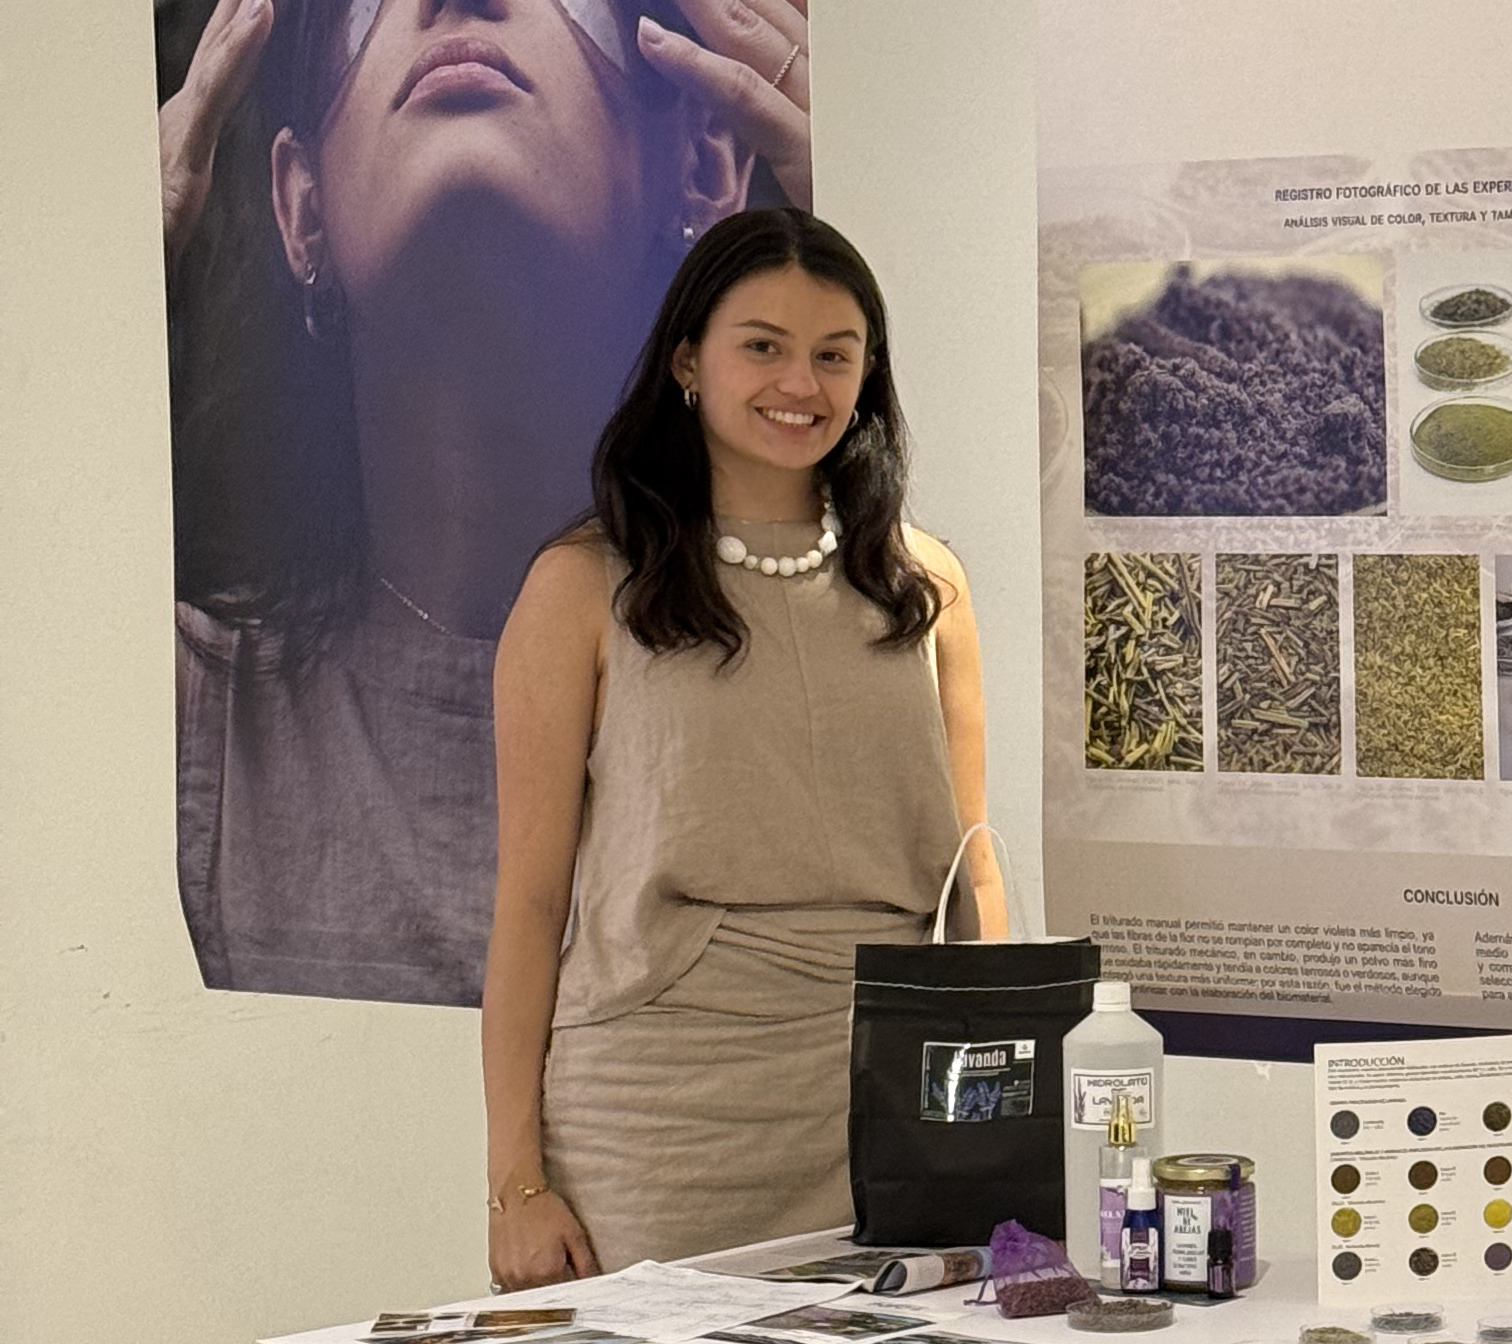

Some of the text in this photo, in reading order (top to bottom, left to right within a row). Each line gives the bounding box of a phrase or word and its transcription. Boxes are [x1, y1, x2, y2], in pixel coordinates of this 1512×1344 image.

[1275, 187, 1332, 201] REGISTRO
[1336, 183, 1421, 199] FOTOGRÁFICO
[1425, 182, 1440, 195] DE
[1446, 182, 1468, 194] LAS
[1331, 215, 1367, 226] VISUAL
[1370, 214, 1383, 225] DE
[1387, 212, 1425, 226] COLOR,
[1429, 210, 1476, 223] TEXTURA
[1480, 210, 1487, 221] Y
[1404, 888, 1499, 906] CONCLUSIÓN
